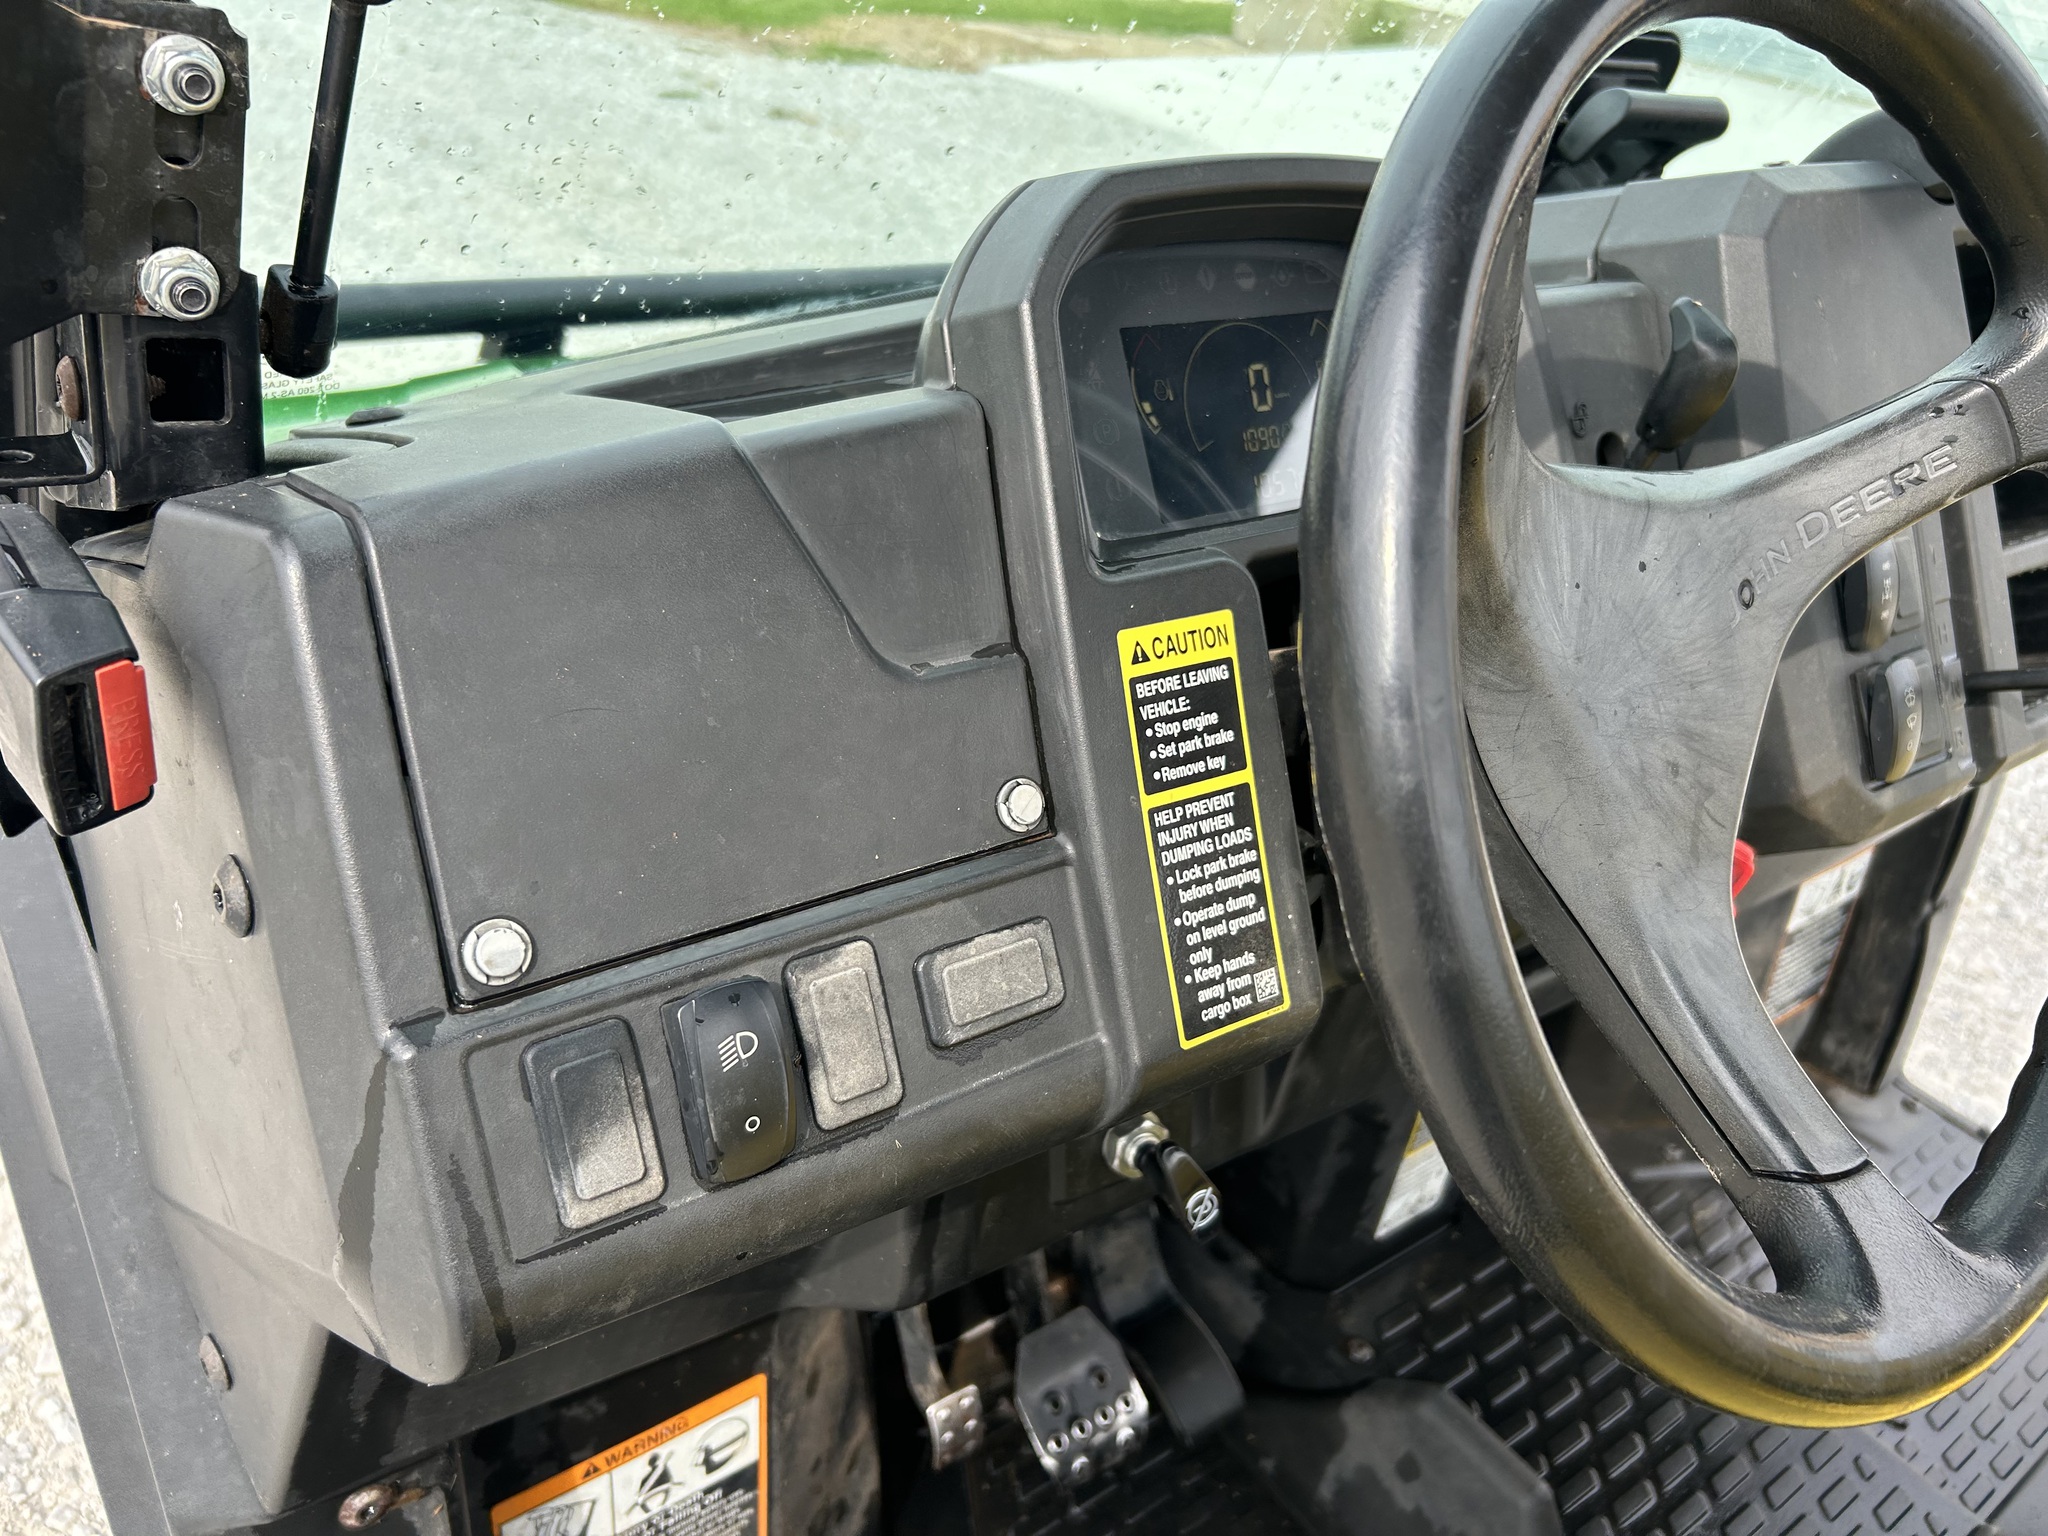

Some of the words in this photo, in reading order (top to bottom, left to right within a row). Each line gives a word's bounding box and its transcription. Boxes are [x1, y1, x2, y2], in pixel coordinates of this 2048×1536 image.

[1248, 363, 1273, 412] 0
[1729, 538, 1792, 629] JOHN
[1795, 444, 1958, 550] DEERE
[1152, 623, 1229, 660] CAUTION
[1135, 675, 1182, 699] BEFORE
[1182, 664, 1230, 688] LEAVING
[1139, 696, 1191, 720] VEHICLE:
[1154, 721, 1181, 738] Stop
[1182, 711, 1219, 732] engine
[109, 695, 146, 779] PRESS
[1157, 741, 1177, 759] Set
[1178, 735, 1204, 758] park
[1203, 728, 1235, 748] brake
[1160, 760, 1206, 782] Remove
[1206, 755, 1226, 771] key
[1154, 806, 1183, 828] HELP
[1184, 791, 1235, 819] PREVENT
[1157, 821, 1198, 847] INJURY
[1199, 812, 1235, 835] WHEN
[1161, 838, 1214, 867] DUMPING
[1214, 826, 1253, 851] LOADS
[1175, 863, 1203, 885] Lock
[1203, 856, 1228, 880] park
[1227, 848, 1257, 869] brake
[1178, 882, 1214, 904] before
[1214, 868, 1261, 892] dumping
[1182, 902, 1225, 928] Operate
[1225, 892, 1256, 913] dump
[1186, 931, 1202, 946] on
[1201, 919, 1228, 941] level
[1228, 906, 1266, 936] ground
[1189, 946, 1212, 965] only
[1193, 963, 1222, 984] Keep
[1222, 950, 1256, 974] hands
[1197, 982, 1225, 1003] away
[1225, 973, 1252, 992] from
[1201, 1001, 1231, 1022] cargo
[1231, 993, 1252, 1010] box
[605, 1416, 689, 1468] WARNING
